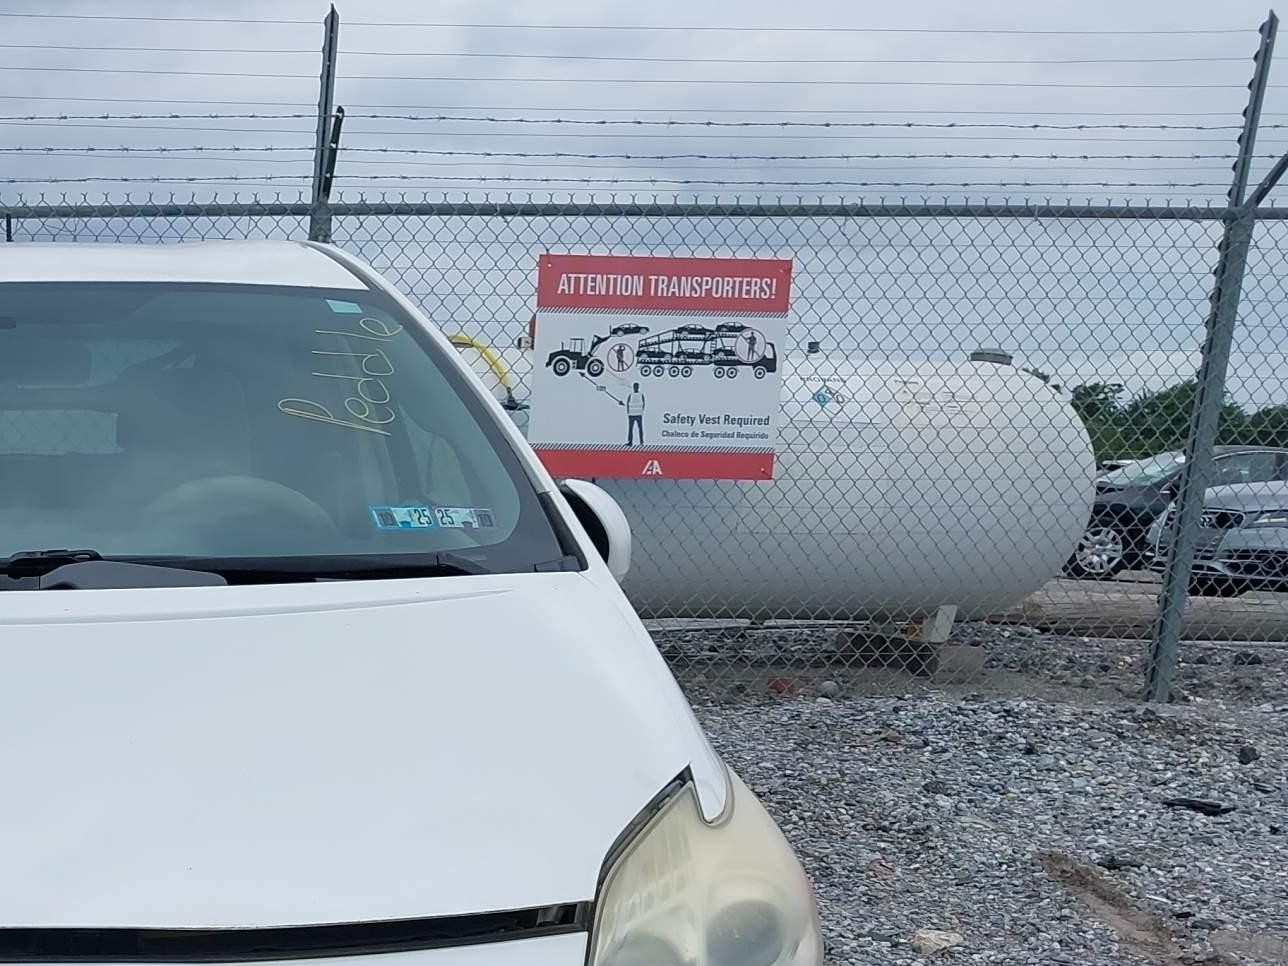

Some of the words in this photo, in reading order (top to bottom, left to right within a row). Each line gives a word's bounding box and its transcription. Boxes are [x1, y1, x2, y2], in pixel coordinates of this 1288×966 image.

[557, 273, 644, 297] ATTENTION
[648, 275, 777, 299] TRANSPORTERS!
[663, 412, 697, 427] Safety
[698, 413, 721, 425] Vest
[723, 414, 771, 428] Required
[661, 430, 689, 438] Chaleco
[690, 430, 699, 438] de
[700, 430, 735, 440] Seguridad
[413, 508, 433, 525] 25
[436, 508, 455, 525] 25
